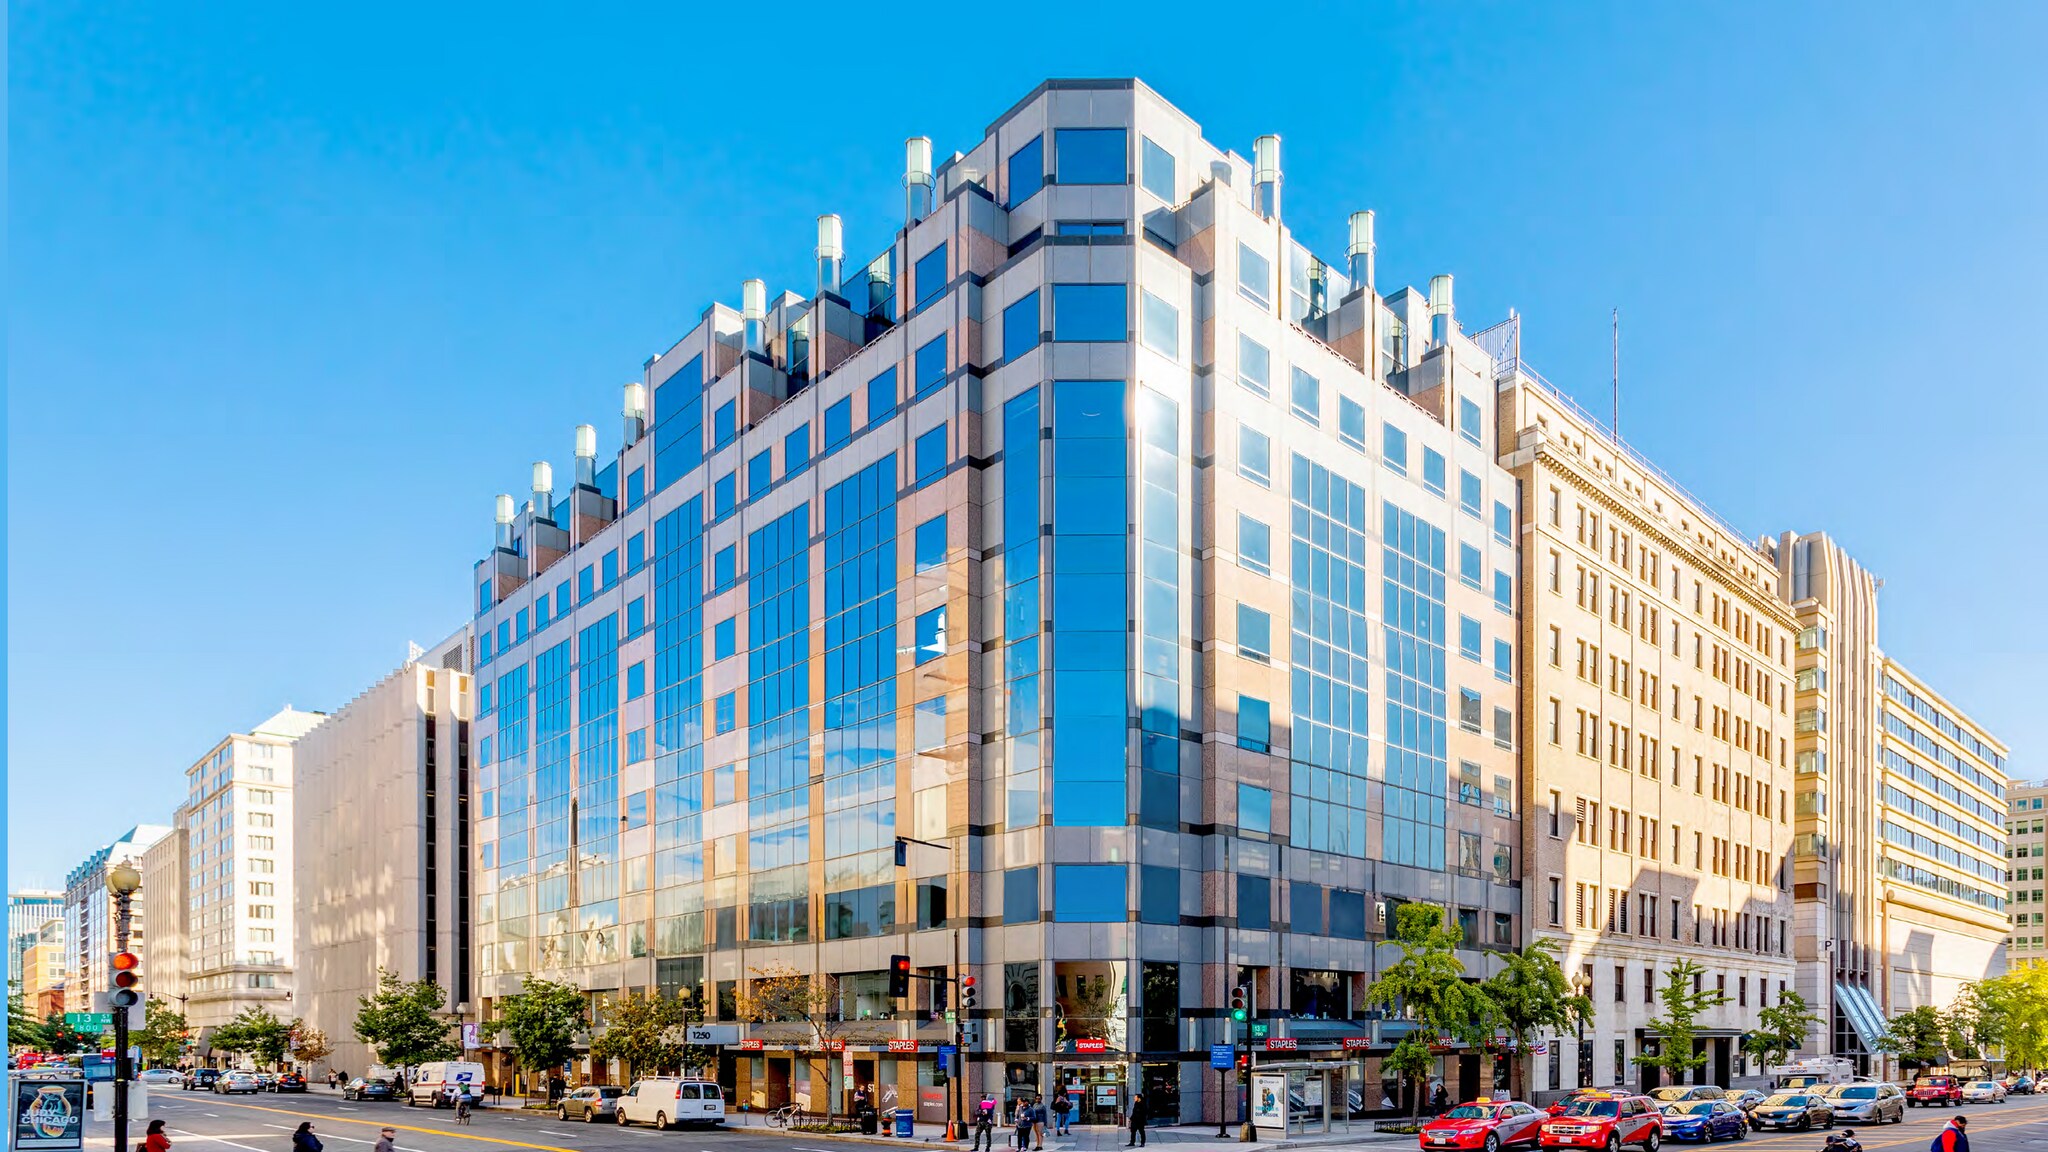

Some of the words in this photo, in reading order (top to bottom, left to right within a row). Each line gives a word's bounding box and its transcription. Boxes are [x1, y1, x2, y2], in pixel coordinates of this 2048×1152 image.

[76, 1013, 91, 1023] 13
[692, 1031, 711, 1040] 1250
[888, 1041, 914, 1050] STAPLES
[1269, 1040, 1298, 1049] STAPLES
[1345, 1039, 1370, 1048] STAPLES
[21, 1109, 55, 1117] JUDY
[21, 1116, 78, 1124] CHICAGO
